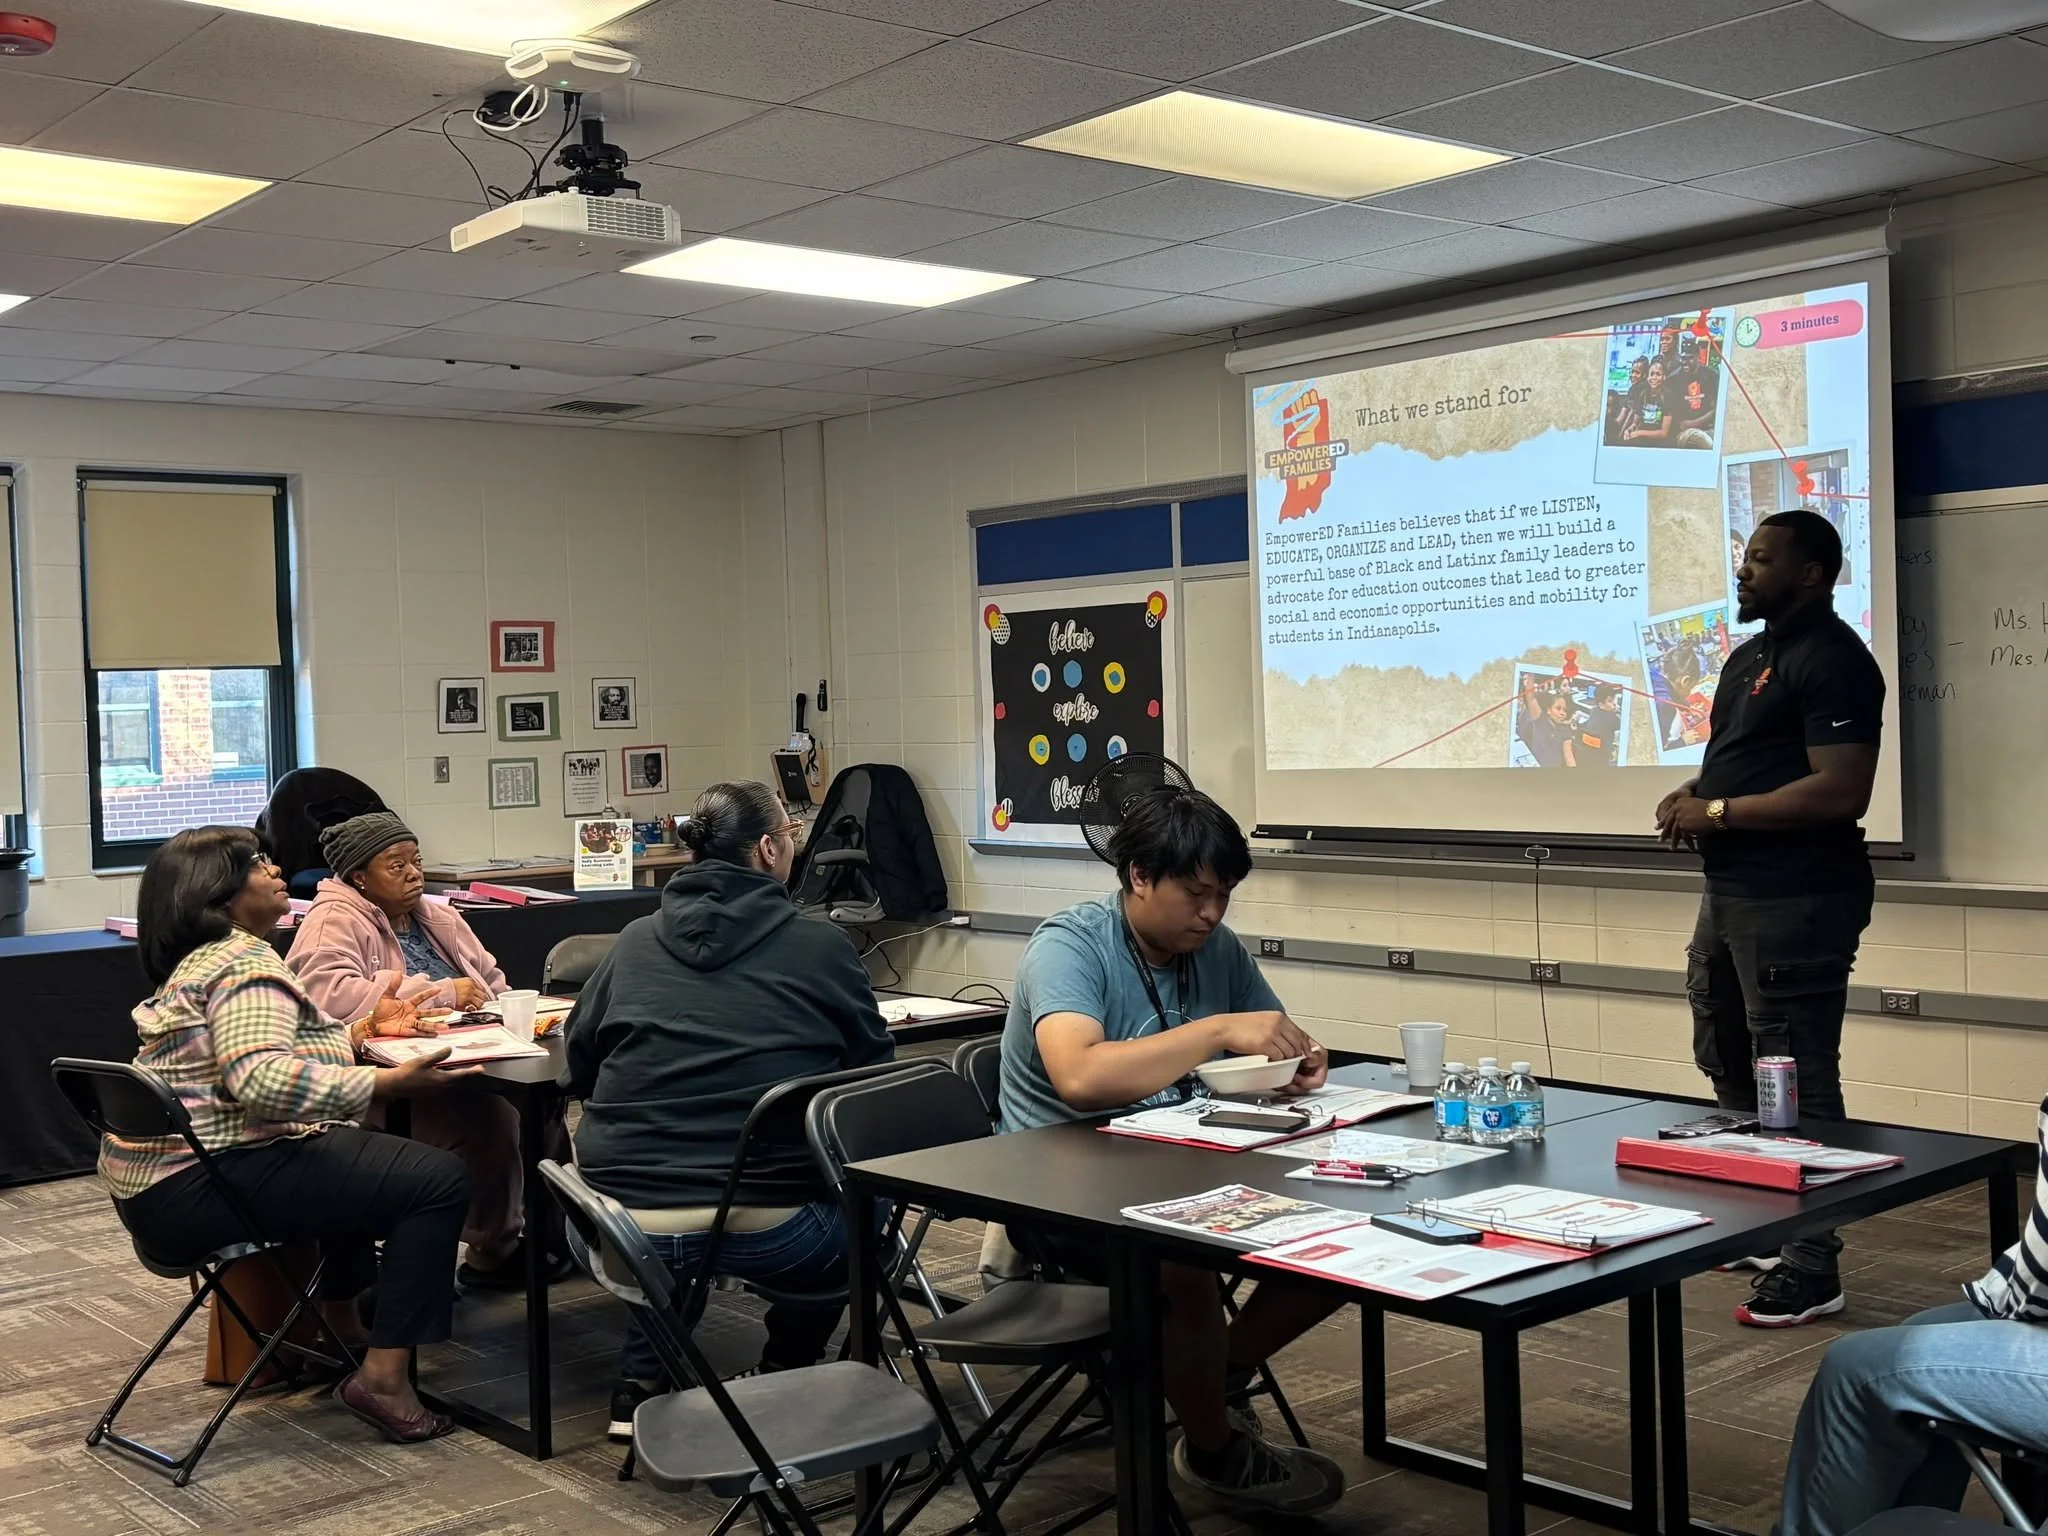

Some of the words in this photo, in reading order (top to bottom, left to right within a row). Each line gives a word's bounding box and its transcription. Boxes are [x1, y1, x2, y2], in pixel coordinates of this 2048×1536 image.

[1781, 321, 1788, 332] 3
[1791, 315, 1839, 330] minutes
[1355, 403, 1400, 427] What
[1405, 403, 1429, 419] we
[1435, 388, 1492, 415] stand
[1497, 385, 1532, 407] for
[1270, 442, 1346, 467] EMPOWERED
[1284, 458, 1332, 477] FAMILIES
[1265, 525, 1334, 547] EmpowerED
[1337, 520, 1396, 538] Families
[1400, 514, 1461, 531] believes
[1465, 507, 1496, 524] that
[1500, 504, 1517, 520] if
[1520, 506, 1538, 518] we
[1542, 495, 1601, 515] LISTEN,
[1266, 548, 1323, 566] EDUCATE,
[1326, 540, 1386, 560] ORGANIZE
[1390, 538, 1415, 552] and
[1418, 534, 1456, 550] LEAD,
[1460, 530, 1493, 546] then
[1497, 530, 1515, 542] we
[1519, 524, 1554, 539] will
[1557, 518, 1602, 536] build
[1607, 520, 1616, 531] a
[1266, 568, 1325, 588] powerful
[1328, 565, 1356, 581] base
[1358, 562, 1373, 576] of
[1376, 558, 1414, 574] Black
[1418, 556, 1442, 570] and
[1446, 553, 1496, 569] Latinx
[1500, 547, 1550, 563] family
[1554, 542, 1614, 559] leaders
[1618, 538, 1635, 552] to
[1267, 590, 1324, 605] advocate
[1328, 588, 1349, 601] for
[1352, 580, 1418, 598] education
[1422, 576, 1487, 590] outcomes
[1490, 570, 1522, 586] that
[1526, 567, 1560, 584] lead
[1564, 566, 1581, 580] to
[1585, 562, 1646, 582] greater
[1268, 610, 1310, 624] social
[1312, 608, 1336, 621] and
[1339, 603, 1399, 620] economic
[1402, 595, 1505, 617] opportunities
[1508, 592, 1536, 606] and
[1540, 586, 1608, 603] mobility
[1612, 584, 1638, 599] for
[1994, 607, 2032, 630] Ms.
[1049, 619, 1095, 655] believe
[1268, 629, 1324, 644] students
[1328, 628, 1344, 641] in
[1347, 621, 1440, 640] Indianapolis.
[1052, 692, 1100, 726] explore
[1050, 775, 1096, 812] bless
